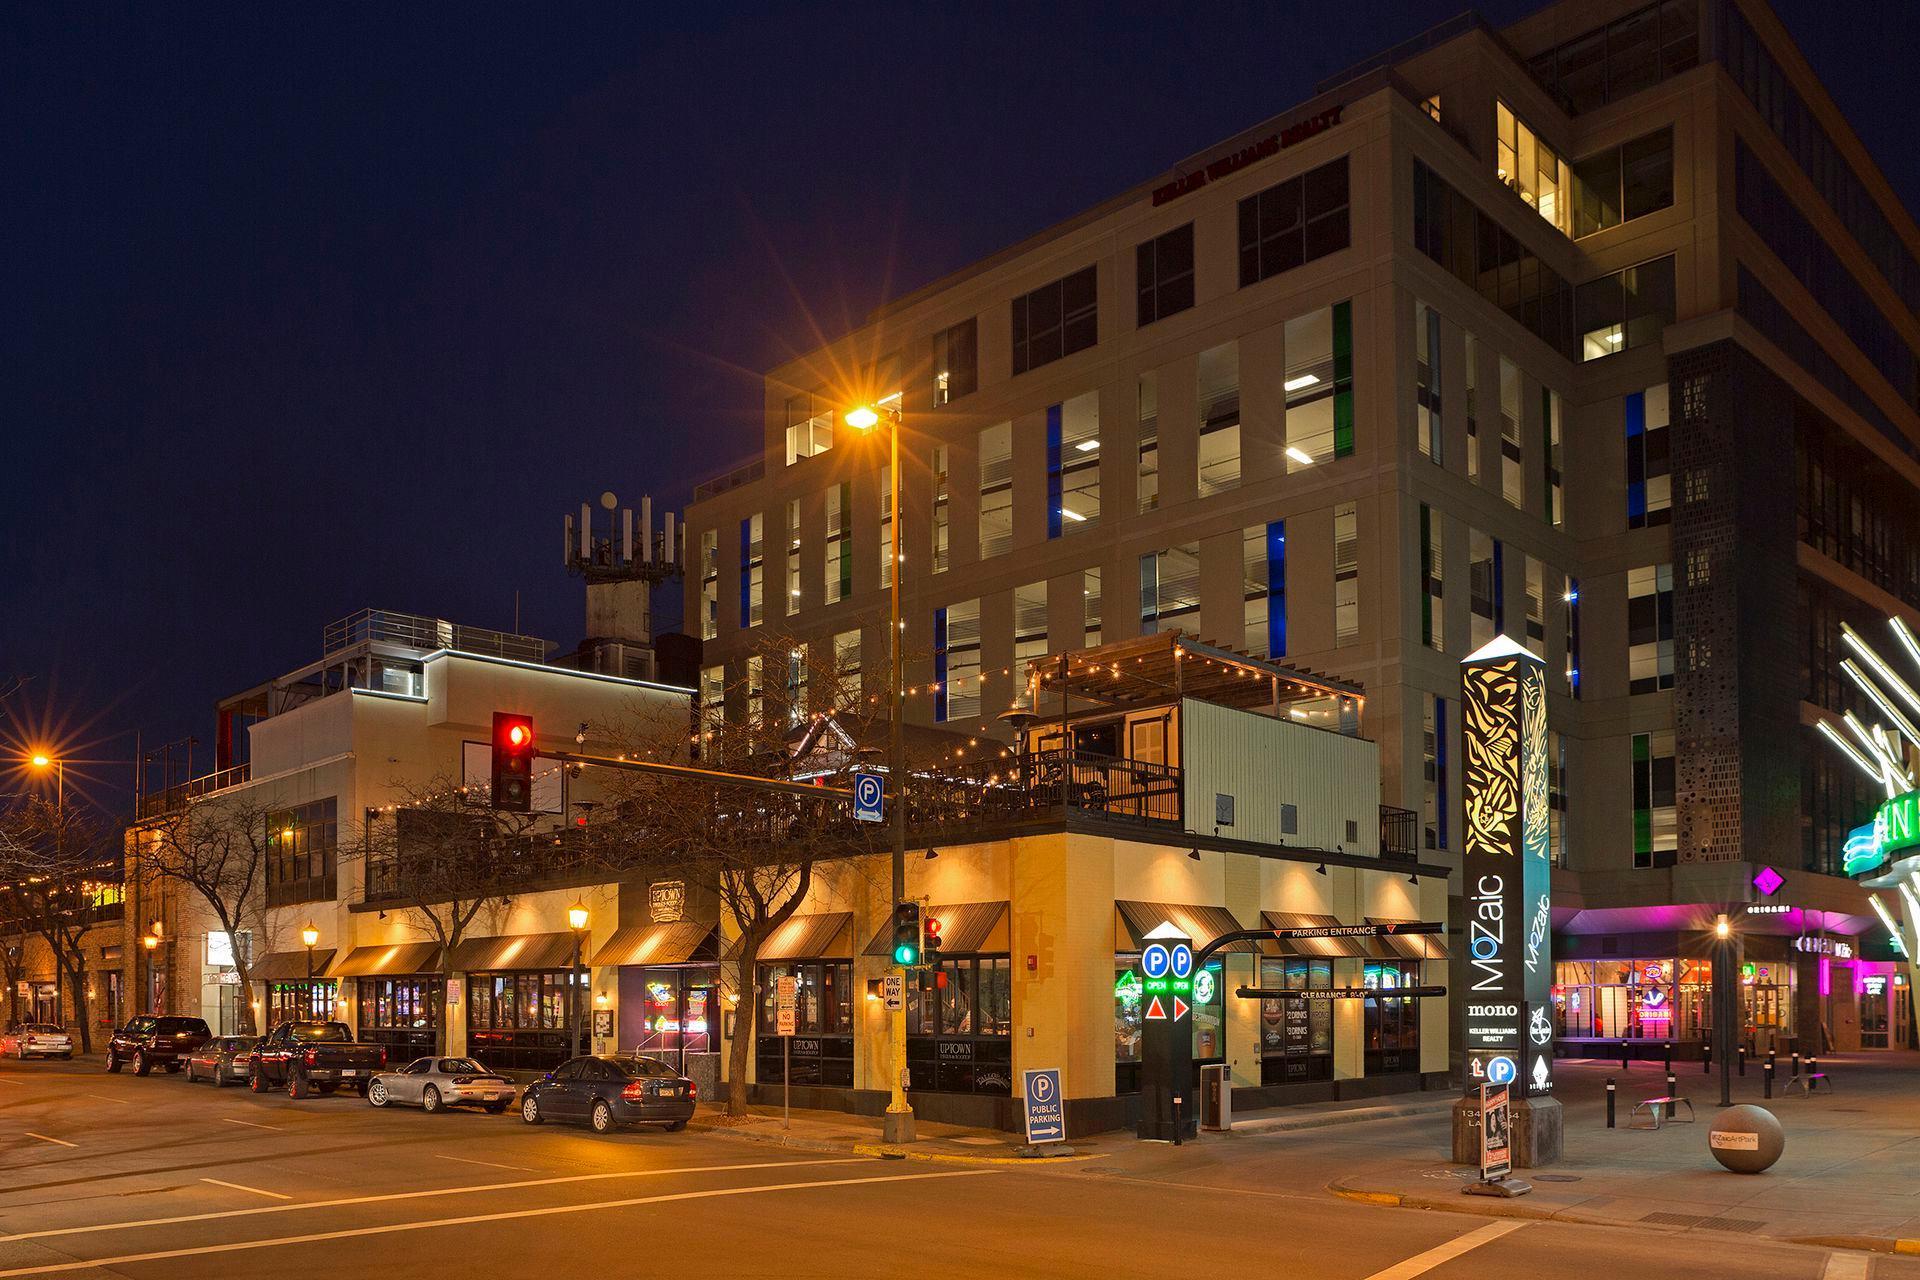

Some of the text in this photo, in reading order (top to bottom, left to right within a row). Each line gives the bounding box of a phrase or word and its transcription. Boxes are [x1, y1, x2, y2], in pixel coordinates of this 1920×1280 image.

[1747, 905, 1791, 914] ORIGAMI
[1291, 926, 1377, 938] PARKING ENTRANCE
[1470, 874, 1504, 991] MoZaic
[886, 977, 901, 987] ONE
[1146, 981, 1189, 990] OPEN OPEN
[886, 987, 901, 997] WAY
[1300, 991, 1347, 999] CLEARANCE
[1467, 1005, 1518, 1017] mono
[940, 1043, 971, 1054] UPTOWN
[1031, 1104, 1057, 1114] PUBLIC
[1029, 1113, 1061, 1124] PARKING
